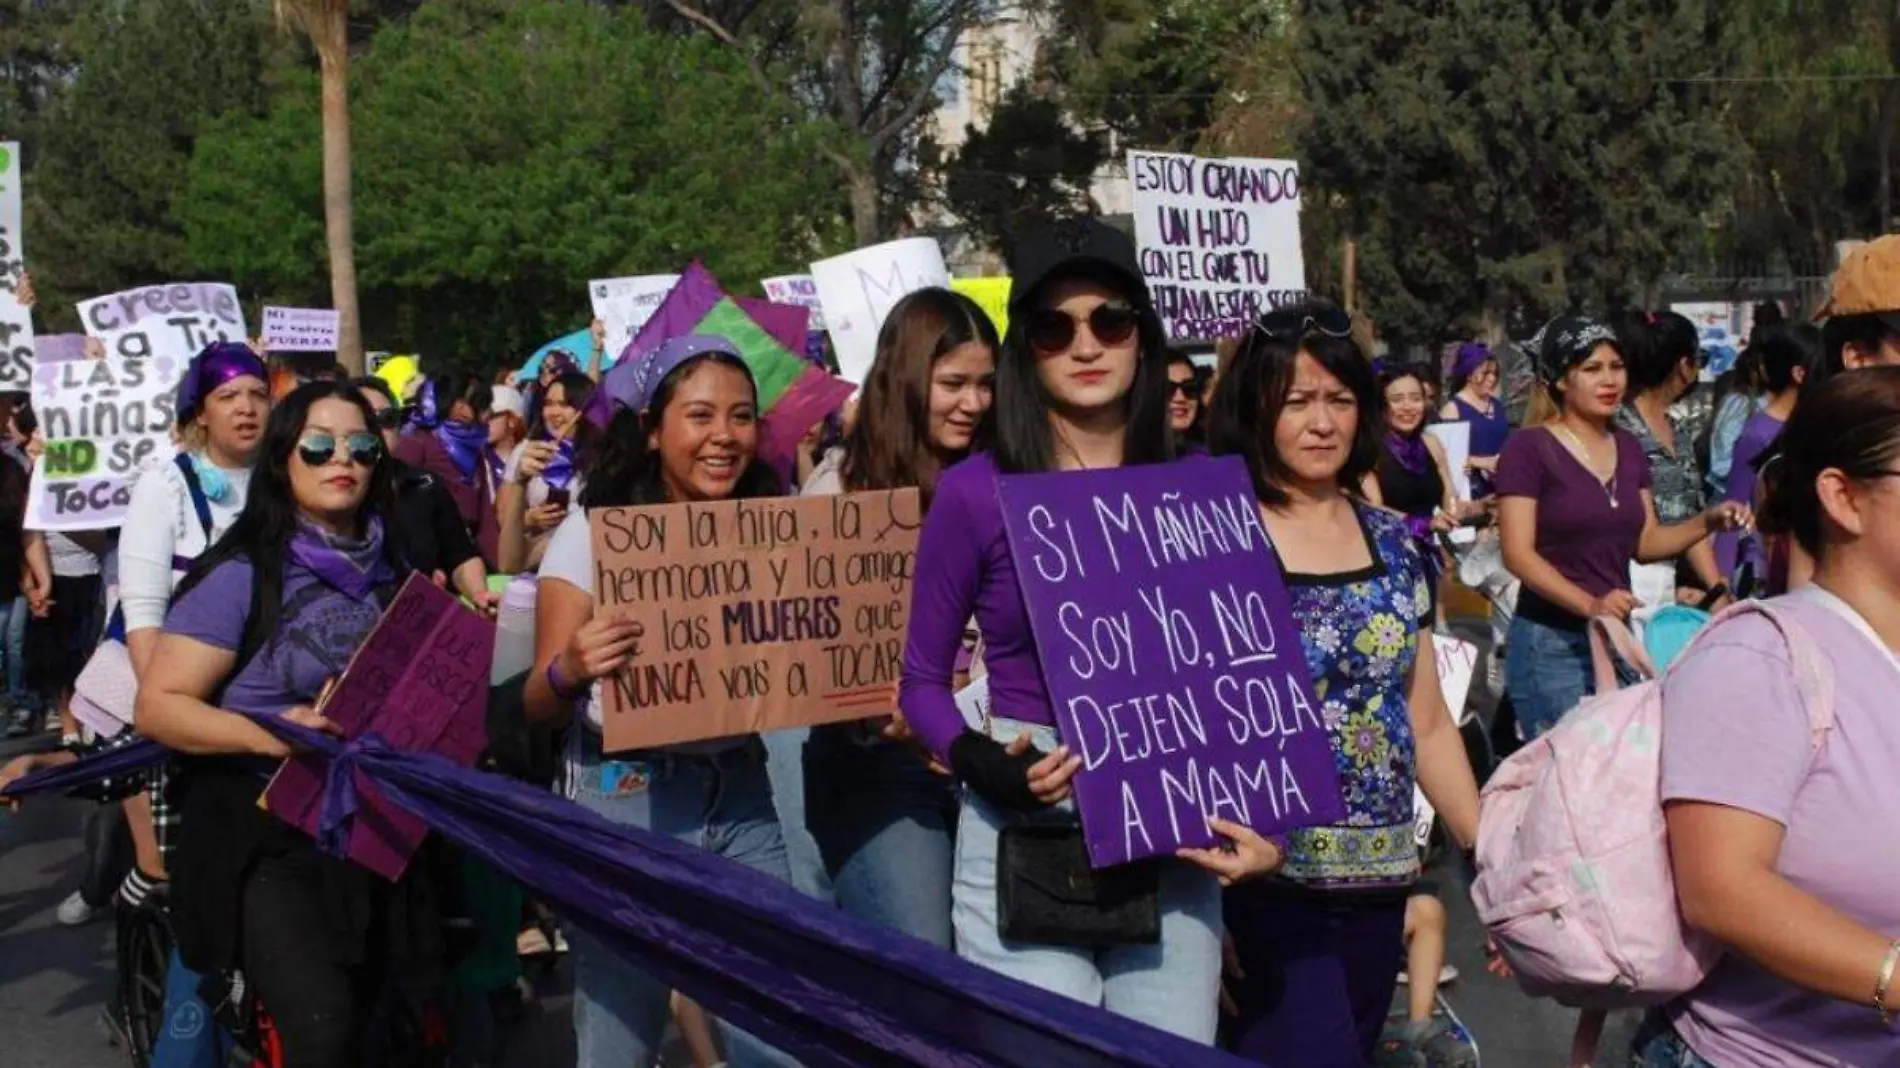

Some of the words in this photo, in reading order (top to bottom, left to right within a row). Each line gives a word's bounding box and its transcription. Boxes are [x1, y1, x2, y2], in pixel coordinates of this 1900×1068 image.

[1135, 154, 1196, 195] ESTOY
[1202, 162, 1299, 203] CRIANDO
[1158, 205, 1191, 246] UN
[1196, 208, 1250, 248] HIJO
[1141, 248, 1173, 278] CON
[1177, 251, 1200, 281] EL
[1203, 252, 1241, 283] QUE
[1241, 251, 1270, 285] TU
[117, 331, 150, 359] a
[62, 360, 146, 389] LAS
[43, 389, 174, 438] niñas
[44, 439, 97, 474] NO
[602, 508, 666, 553] Soy
[686, 504, 718, 548] la
[832, 495, 861, 539] la
[1027, 504, 1086, 582] SI
[1092, 491, 1272, 573] MAÑANA
[597, 559, 752, 606] hermana
[769, 558, 788, 597] y
[806, 548, 836, 589] la
[662, 609, 711, 652] las
[721, 596, 842, 645] MUJERES
[854, 599, 904, 638] que
[1210, 584, 1276, 658] NO
[612, 658, 706, 713] NUNCA
[719, 658, 770, 700] vas
[787, 661, 809, 698] a
[822, 638, 900, 690] TOCAR
[1068, 686, 1208, 771] DEJEN
[1214, 673, 1319, 746] SOLA
[1121, 780, 1154, 862] A
[1160, 737, 1311, 844] MAMÁ
